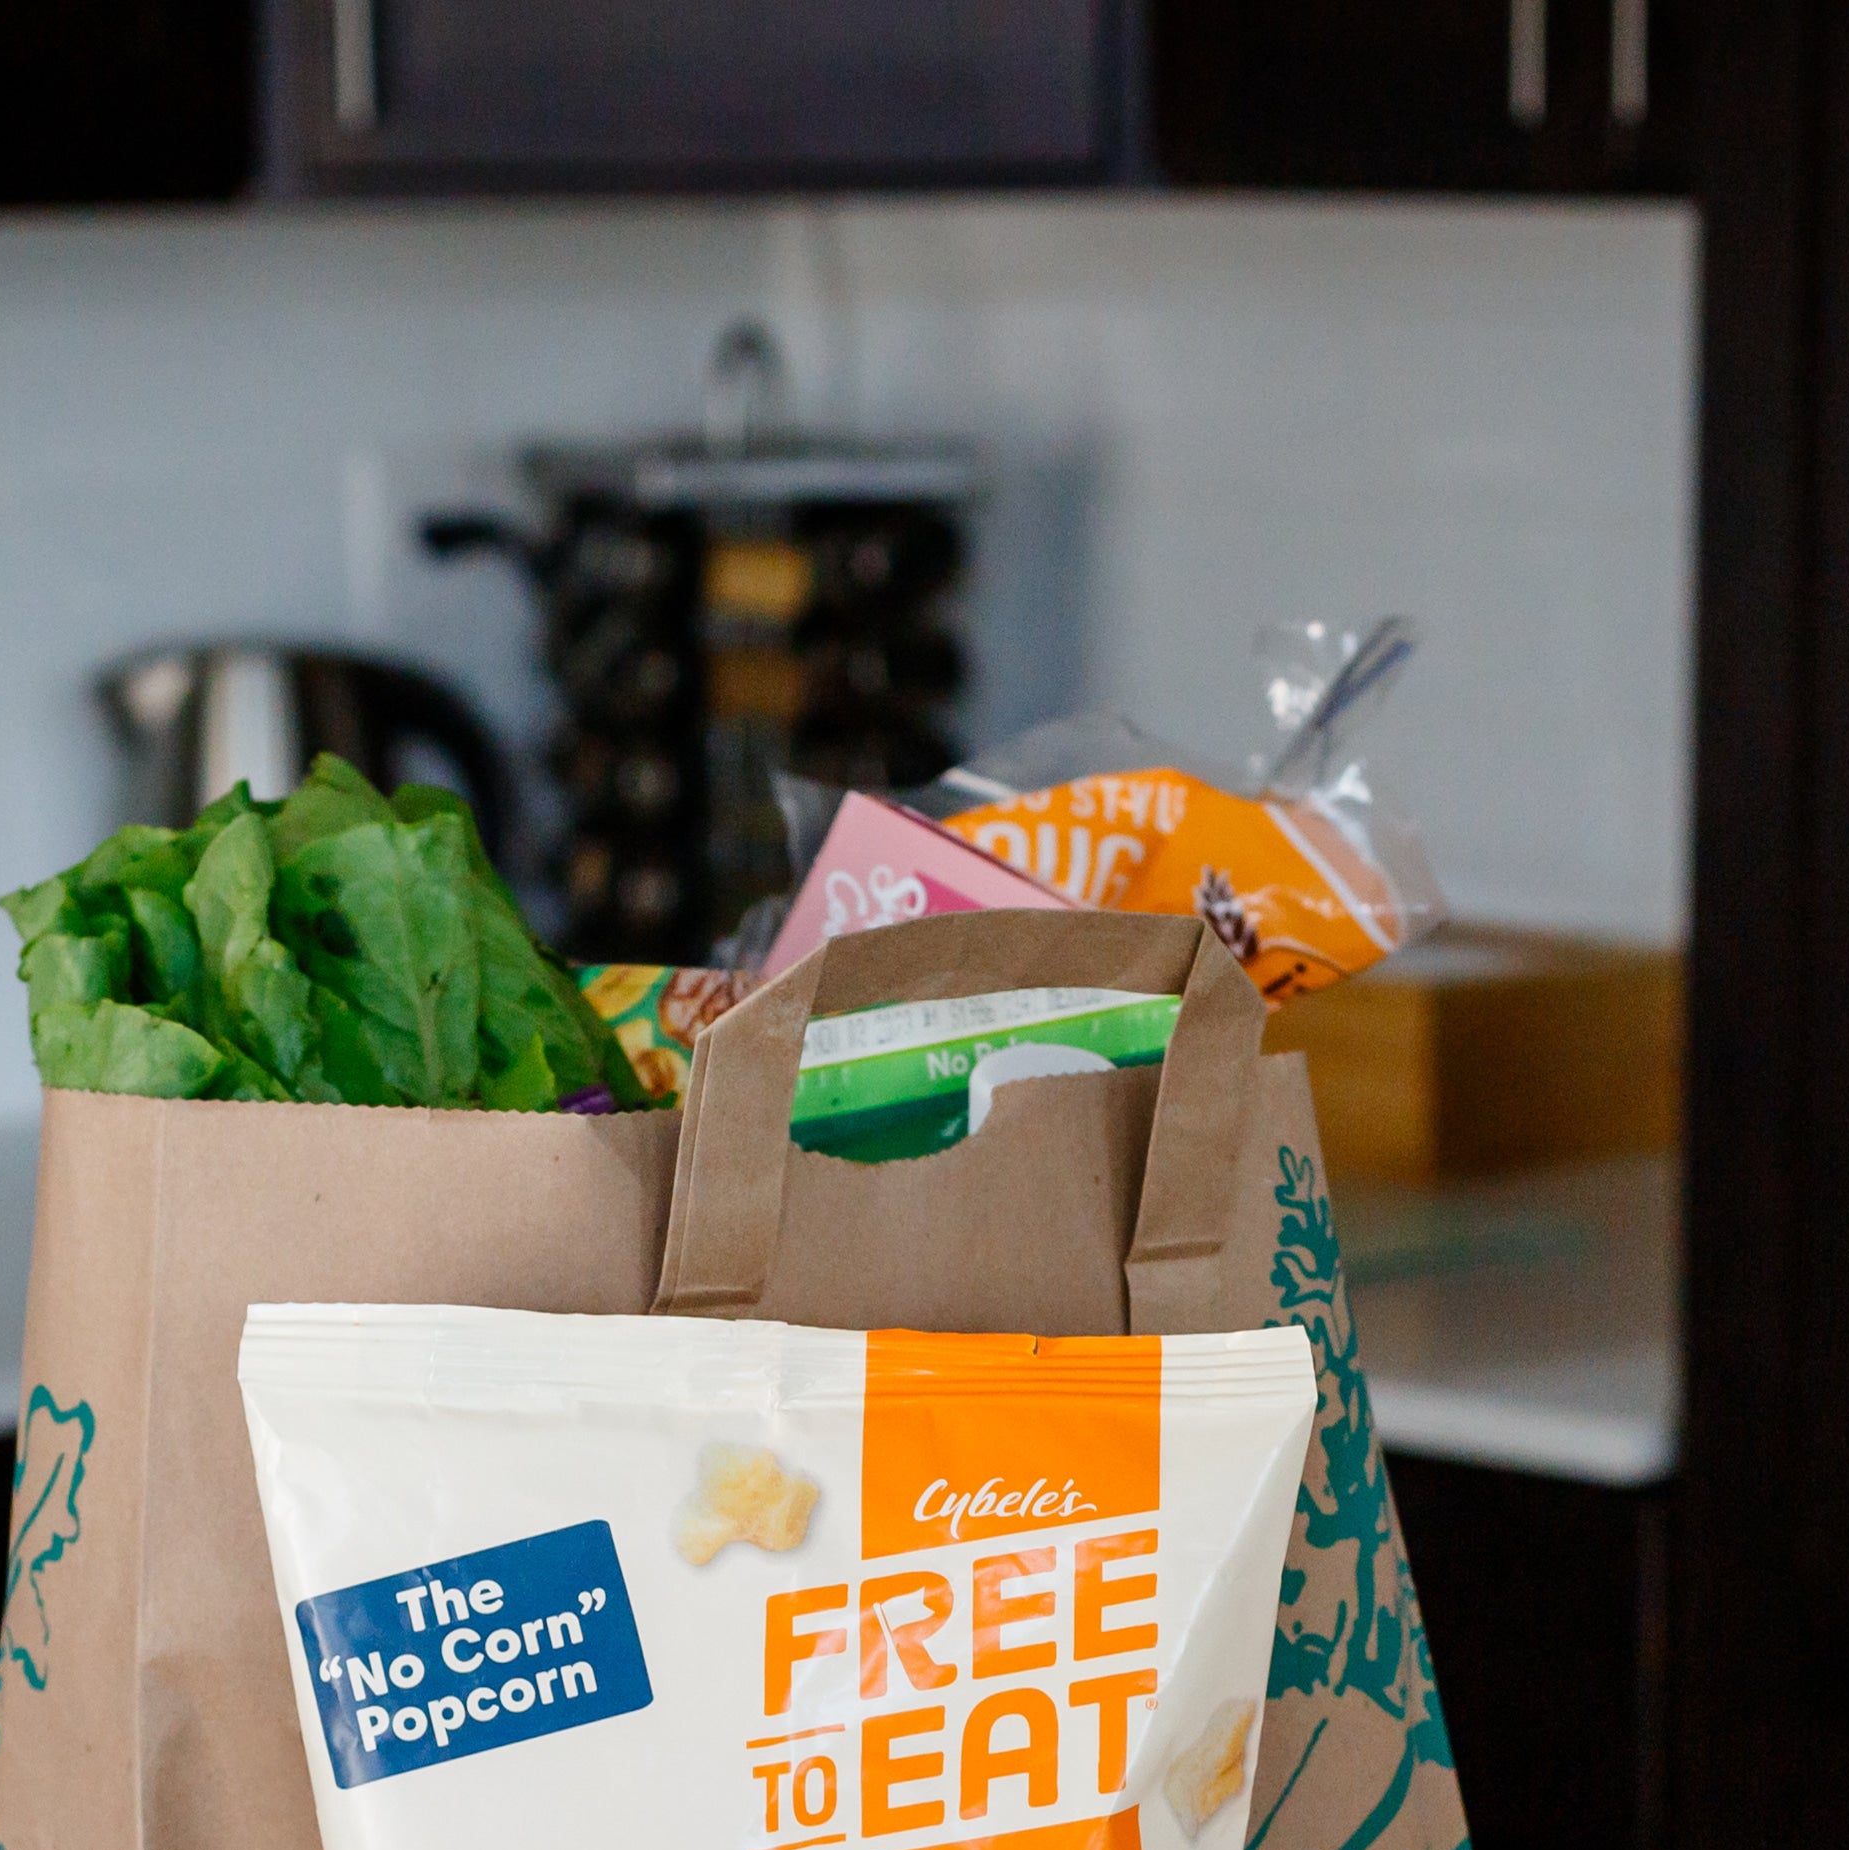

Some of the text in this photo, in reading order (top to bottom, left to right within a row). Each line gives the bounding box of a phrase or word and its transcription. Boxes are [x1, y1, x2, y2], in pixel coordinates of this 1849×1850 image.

[926, 1051, 968, 1081] No
[913, 1477, 1097, 1540] Cybele's
[319, 1587, 607, 1702] “No Corn”
[396, 1579, 504, 1633] The
[763, 1528, 1159, 1716] FREE
[355, 1659, 599, 1753] Popcorn
[752, 1668, 1159, 1839] TO EAT
